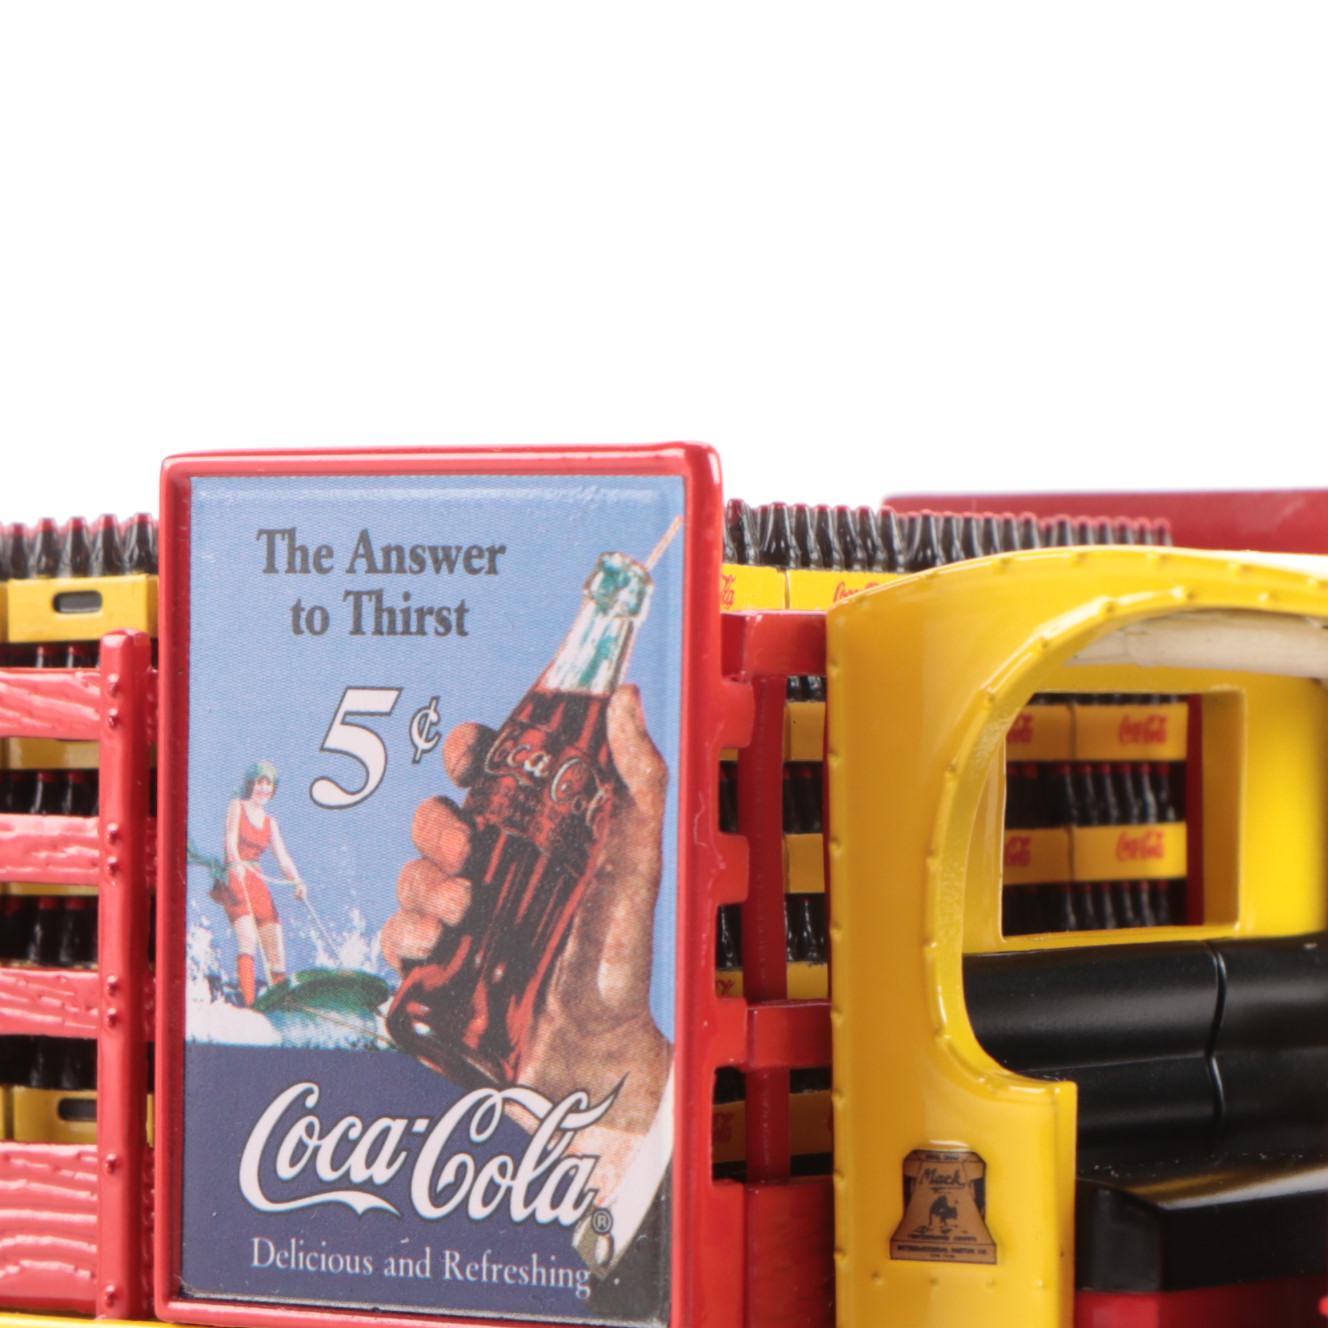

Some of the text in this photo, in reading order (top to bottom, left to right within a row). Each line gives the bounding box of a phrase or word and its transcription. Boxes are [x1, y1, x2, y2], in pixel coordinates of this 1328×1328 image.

[256, 527, 506, 576] The Answer
[291, 589, 470, 637] to Thirst
[238, 1071, 630, 1228] Coca-Cola
[919, 1167, 966, 1186] Mack
[250, 1237, 592, 1299] Delicious and Refreshing
